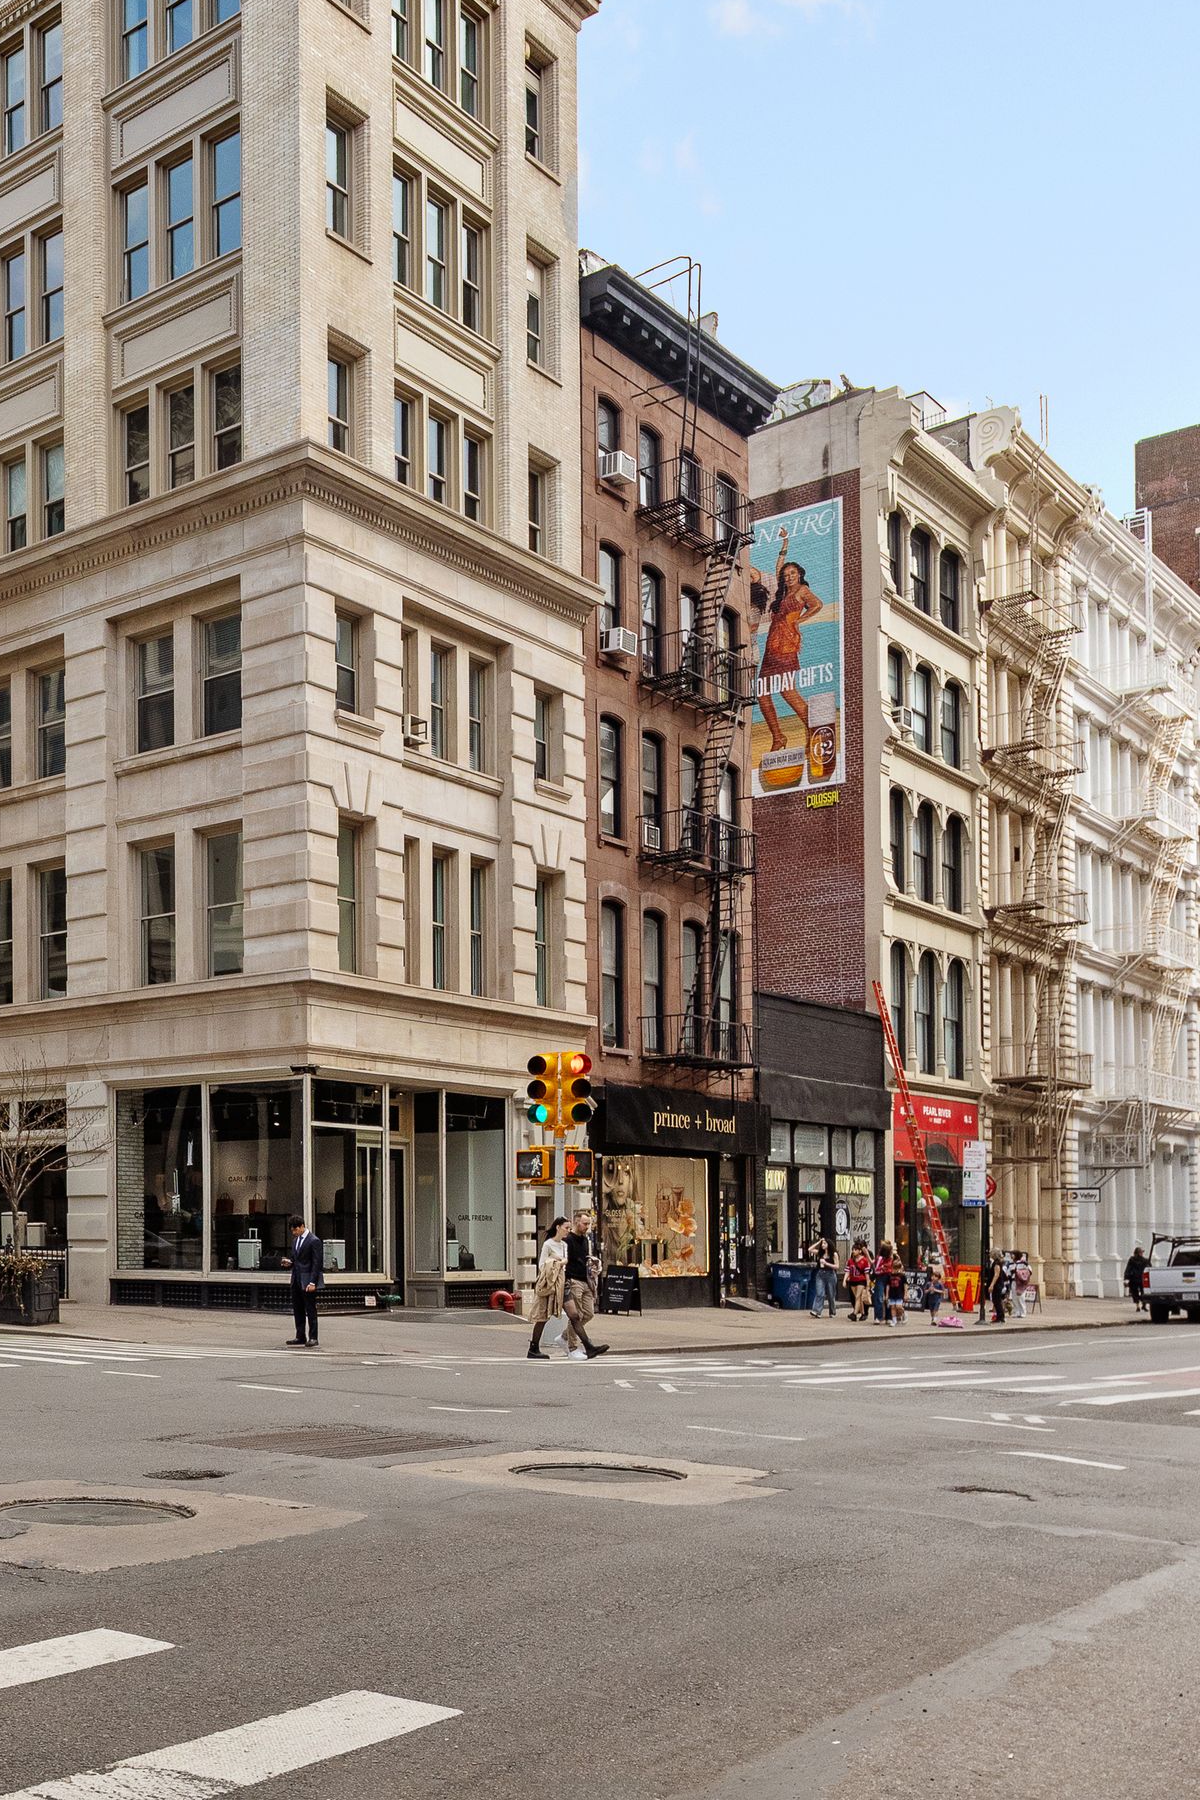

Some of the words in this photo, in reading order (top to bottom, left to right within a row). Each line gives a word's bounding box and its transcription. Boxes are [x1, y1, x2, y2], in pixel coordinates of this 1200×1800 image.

[750, 509, 835, 548] NEIRO
[799, 663, 833, 688] GIFTS
[806, 791, 840, 808] COLOSSAL
[653, 1105, 690, 1134] prince
[695, 1114, 702, 1130] +
[705, 1109, 736, 1134] broad
[923, 1105, 937, 1117] PEARL
[228, 1175, 244, 1183] CARL
